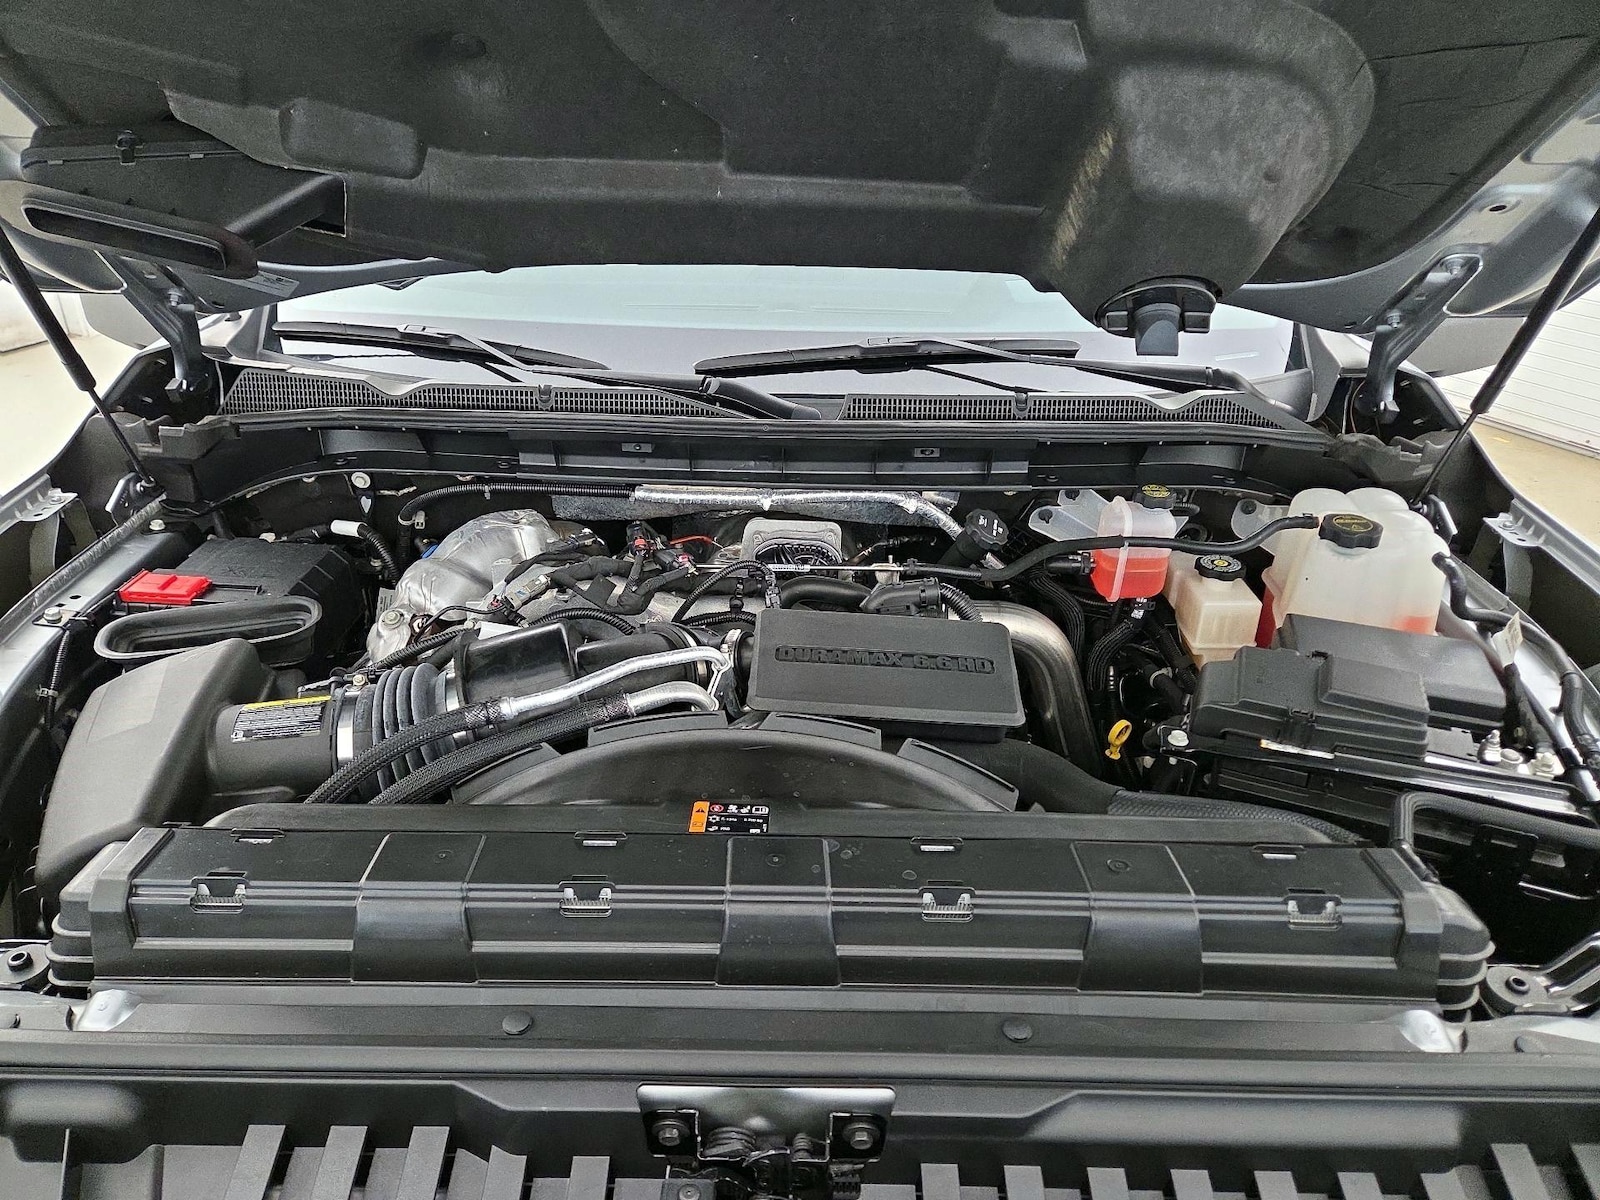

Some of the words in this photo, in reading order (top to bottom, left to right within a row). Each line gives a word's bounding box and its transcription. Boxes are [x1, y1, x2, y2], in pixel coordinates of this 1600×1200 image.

[778, 646, 904, 667] DURAMAX
[912, 653, 952, 671] 6.6
[956, 656, 994, 674] HD
